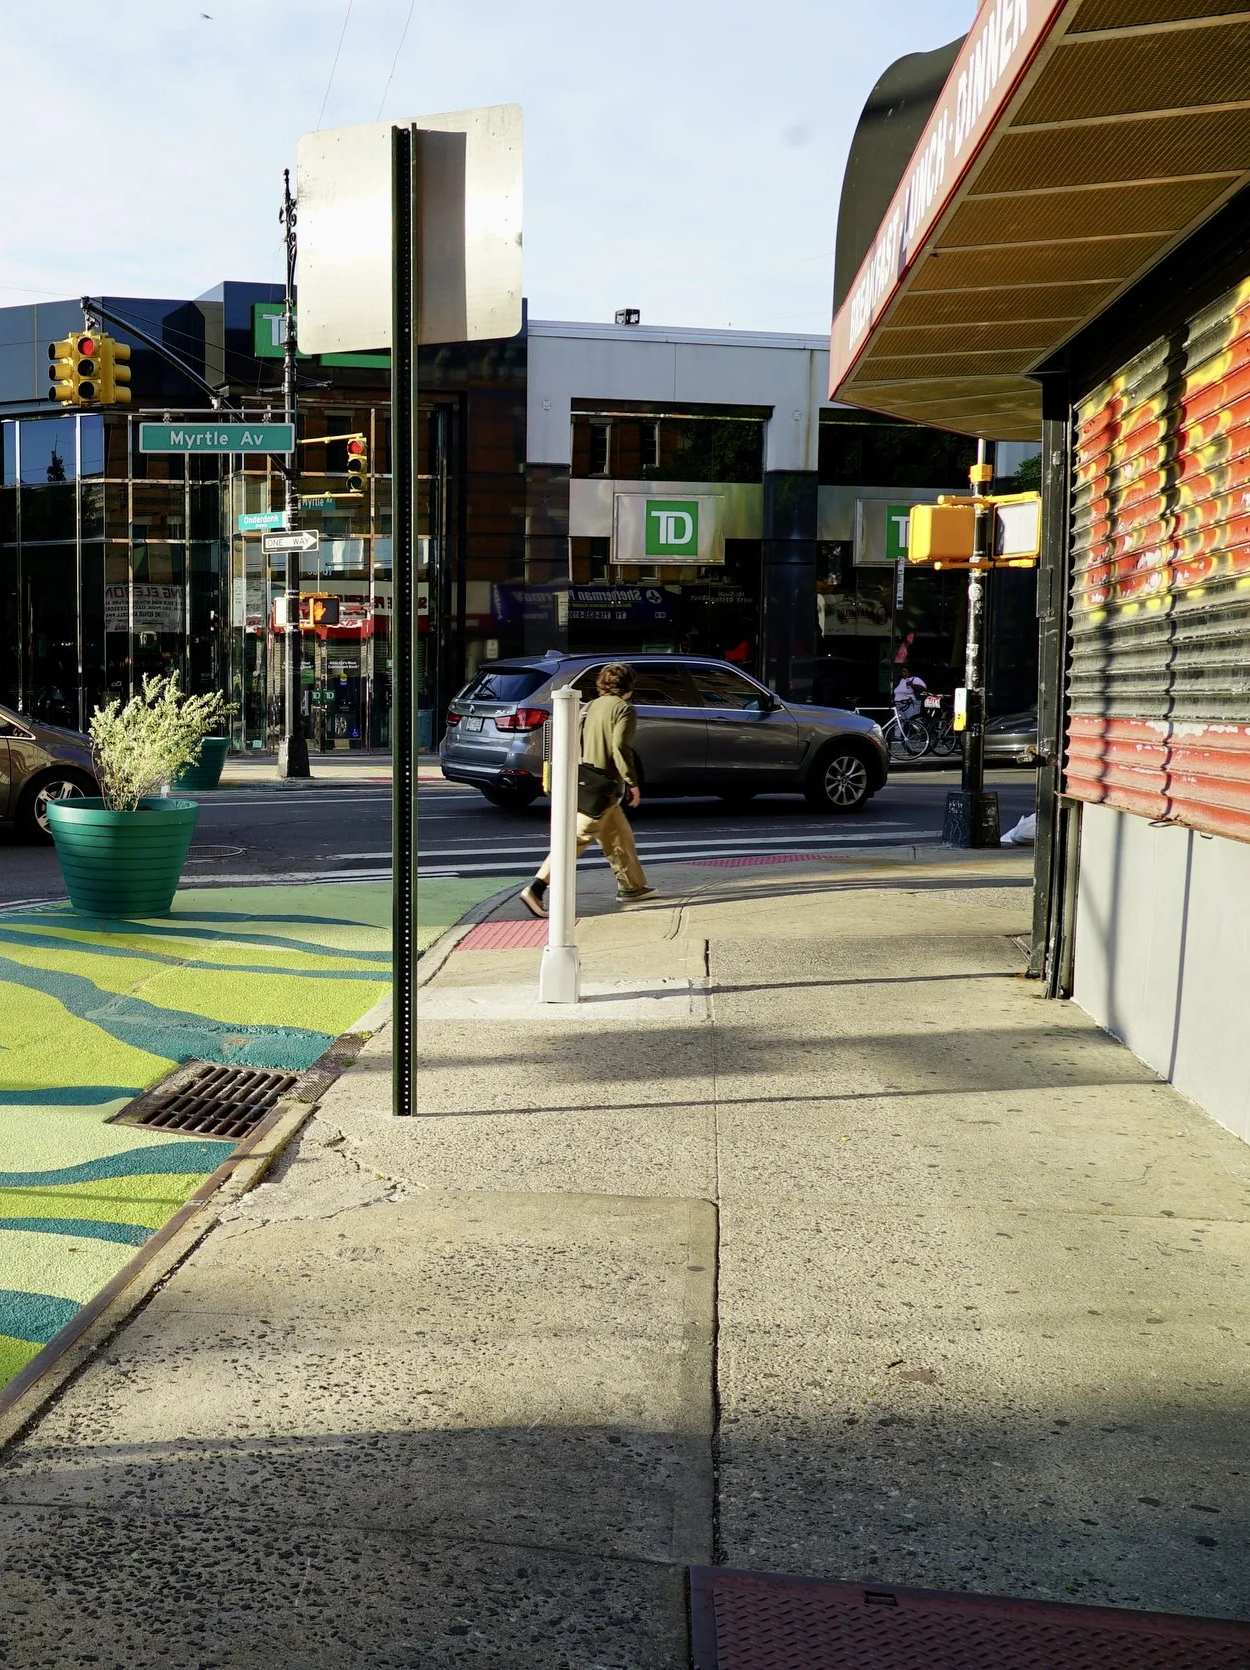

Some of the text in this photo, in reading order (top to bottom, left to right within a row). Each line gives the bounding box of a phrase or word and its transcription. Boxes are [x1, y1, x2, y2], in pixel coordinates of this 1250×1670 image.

[902, 107, 948, 252] LUNCH
[170, 430, 264, 448] Myrtle Av
[302, 497, 324, 509] Myrtle
[243, 514, 279, 524] Onderdonk
[650, 510, 693, 545] TD
[267, 537, 310, 547] ONE WAY
[324, 691, 334, 699] TD
